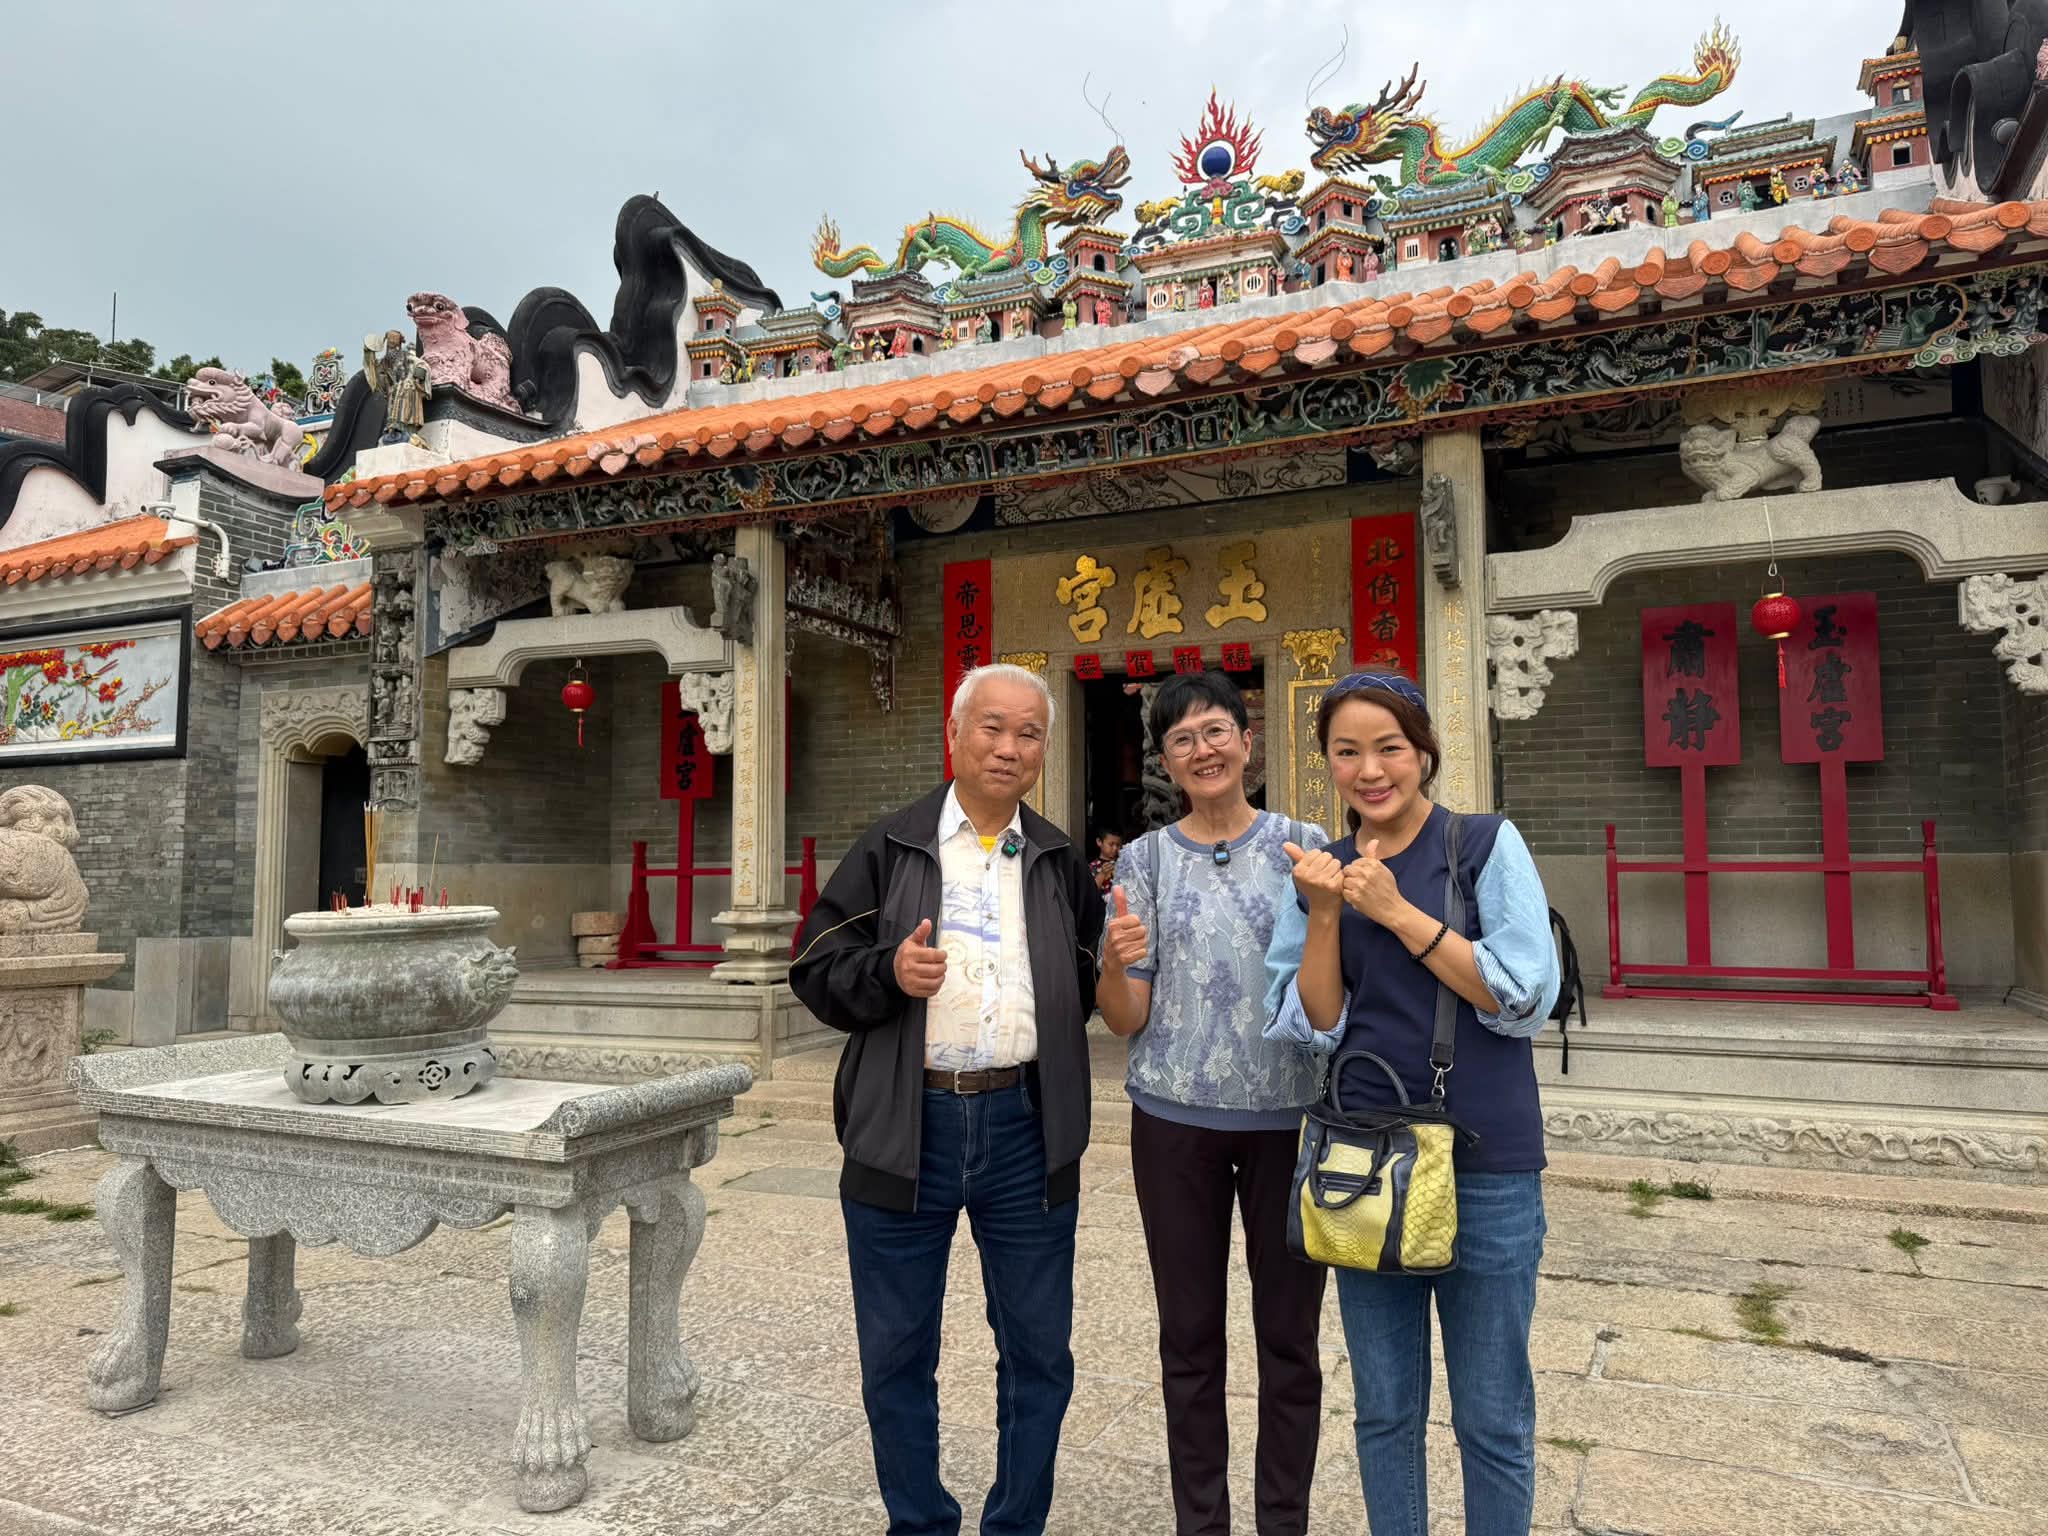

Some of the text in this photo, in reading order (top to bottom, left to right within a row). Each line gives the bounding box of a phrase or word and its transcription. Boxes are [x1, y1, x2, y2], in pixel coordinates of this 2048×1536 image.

[1079, 648, 1248, 676] 恭賀新禧
[1662, 619, 1721, 751] 肅靜
[675, 711, 699, 790] 虛宮
